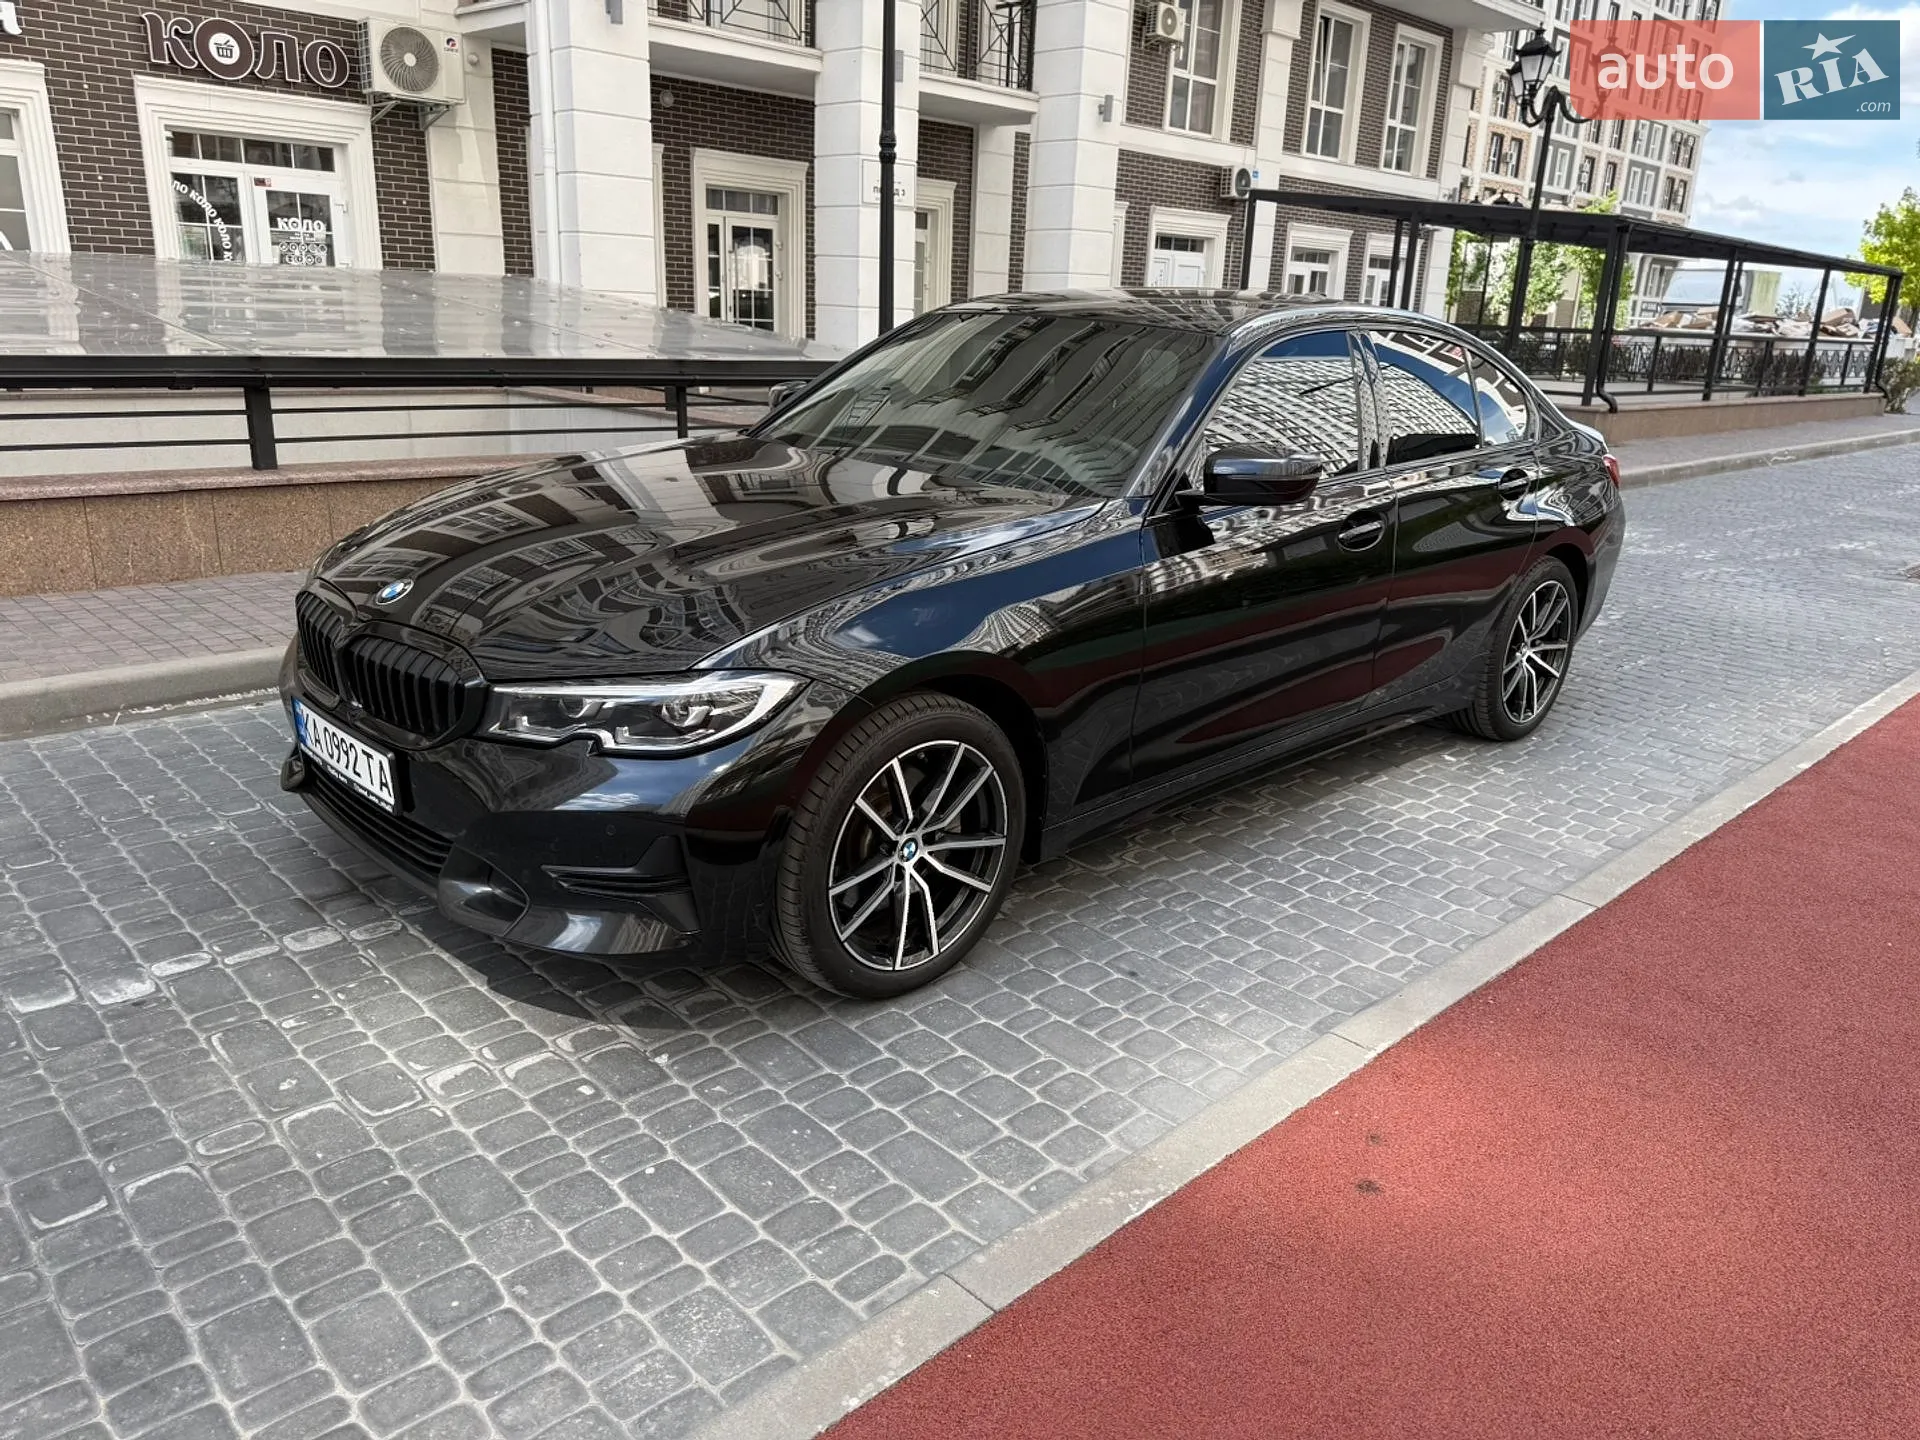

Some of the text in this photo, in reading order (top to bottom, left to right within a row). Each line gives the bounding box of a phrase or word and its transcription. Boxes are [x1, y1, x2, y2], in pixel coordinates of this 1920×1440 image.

[142, 12, 349, 88] КОЛО
[276, 217, 325, 233] КОЛО
[323, 726, 362, 779] 0992
[361, 747, 393, 799] TA
